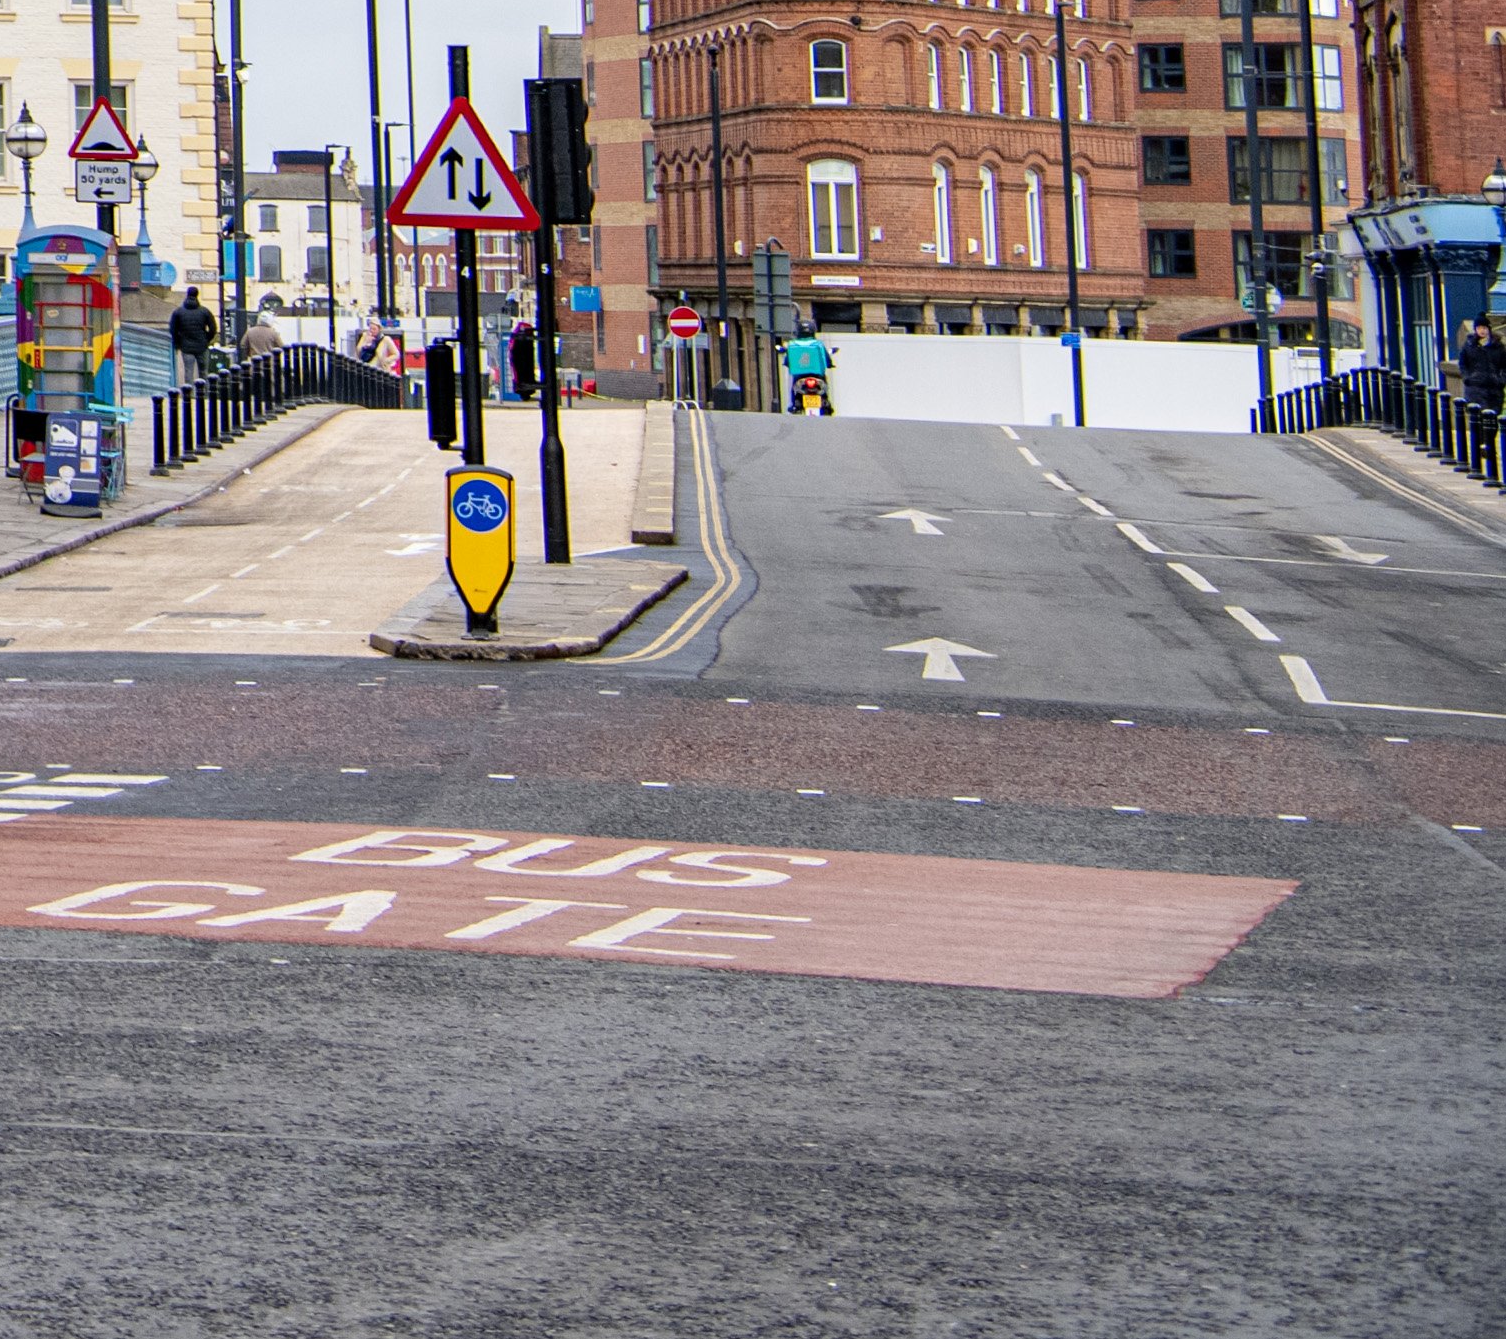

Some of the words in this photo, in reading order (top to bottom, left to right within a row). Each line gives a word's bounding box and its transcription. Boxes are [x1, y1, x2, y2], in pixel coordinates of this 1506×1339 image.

[88, 164, 119, 175] Hump
[81, 175, 95, 183] 50
[98, 176, 127, 185] yards
[461, 266, 472, 279] 4
[541, 263, 549, 275] 5
[288, 829, 829, 889] BUS
[26, 880, 814, 960] GATE
